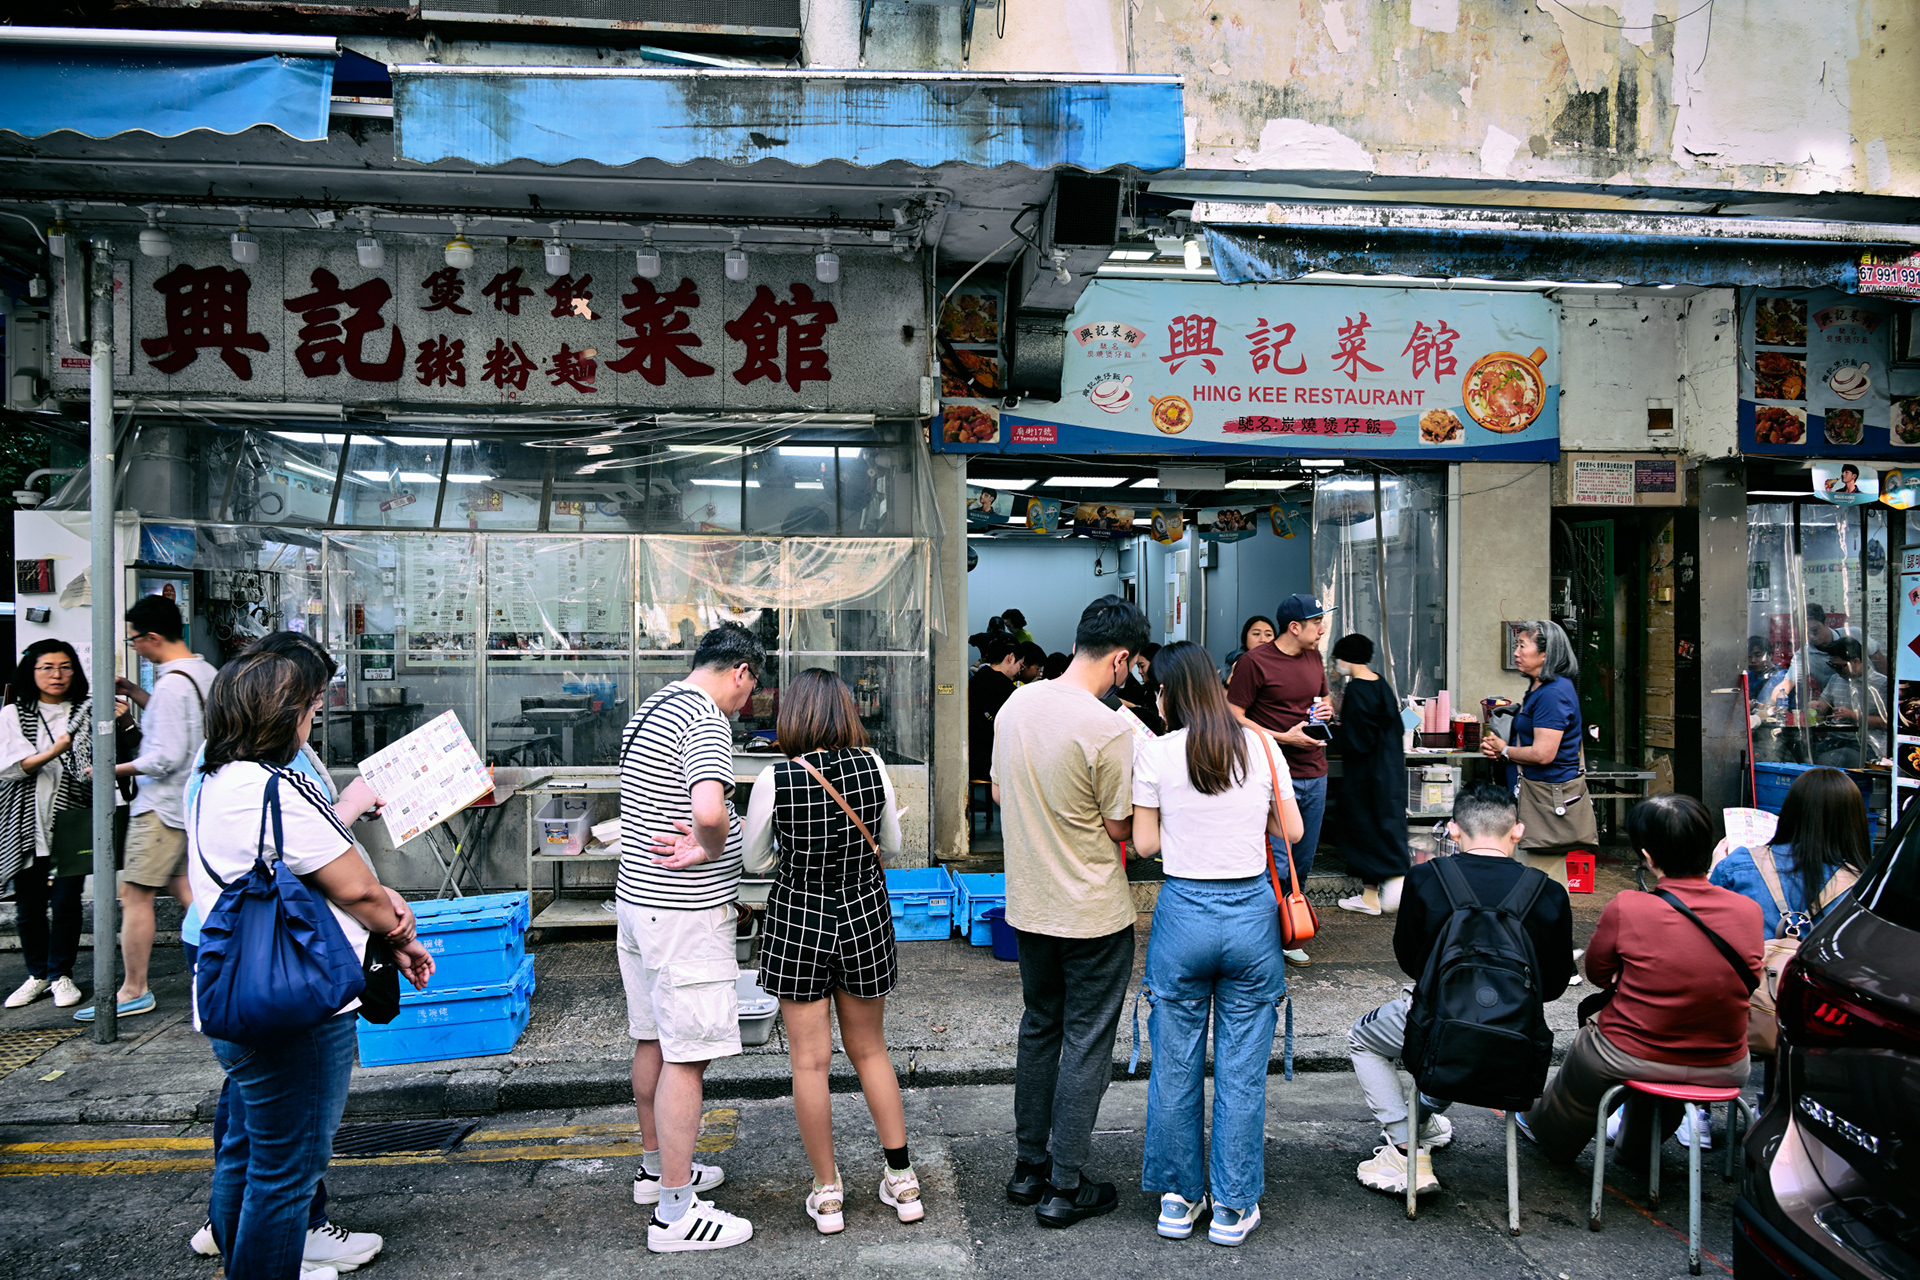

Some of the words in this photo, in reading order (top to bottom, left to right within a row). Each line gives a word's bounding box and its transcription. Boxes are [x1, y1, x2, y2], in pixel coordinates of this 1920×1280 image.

[1859, 265, 1874, 281] 67
[1876, 266, 1898, 282] 991
[140, 263, 406, 382] 興記
[604, 277, 838, 393] 菜館
[1080, 324, 1138, 344] 興記菜館
[1159, 311, 1461, 384] 興記菜館
[1193, 385, 1242, 403] HING
[1249, 386, 1288, 404] KEE
[1294, 387, 1426, 406] RESTAURANT
